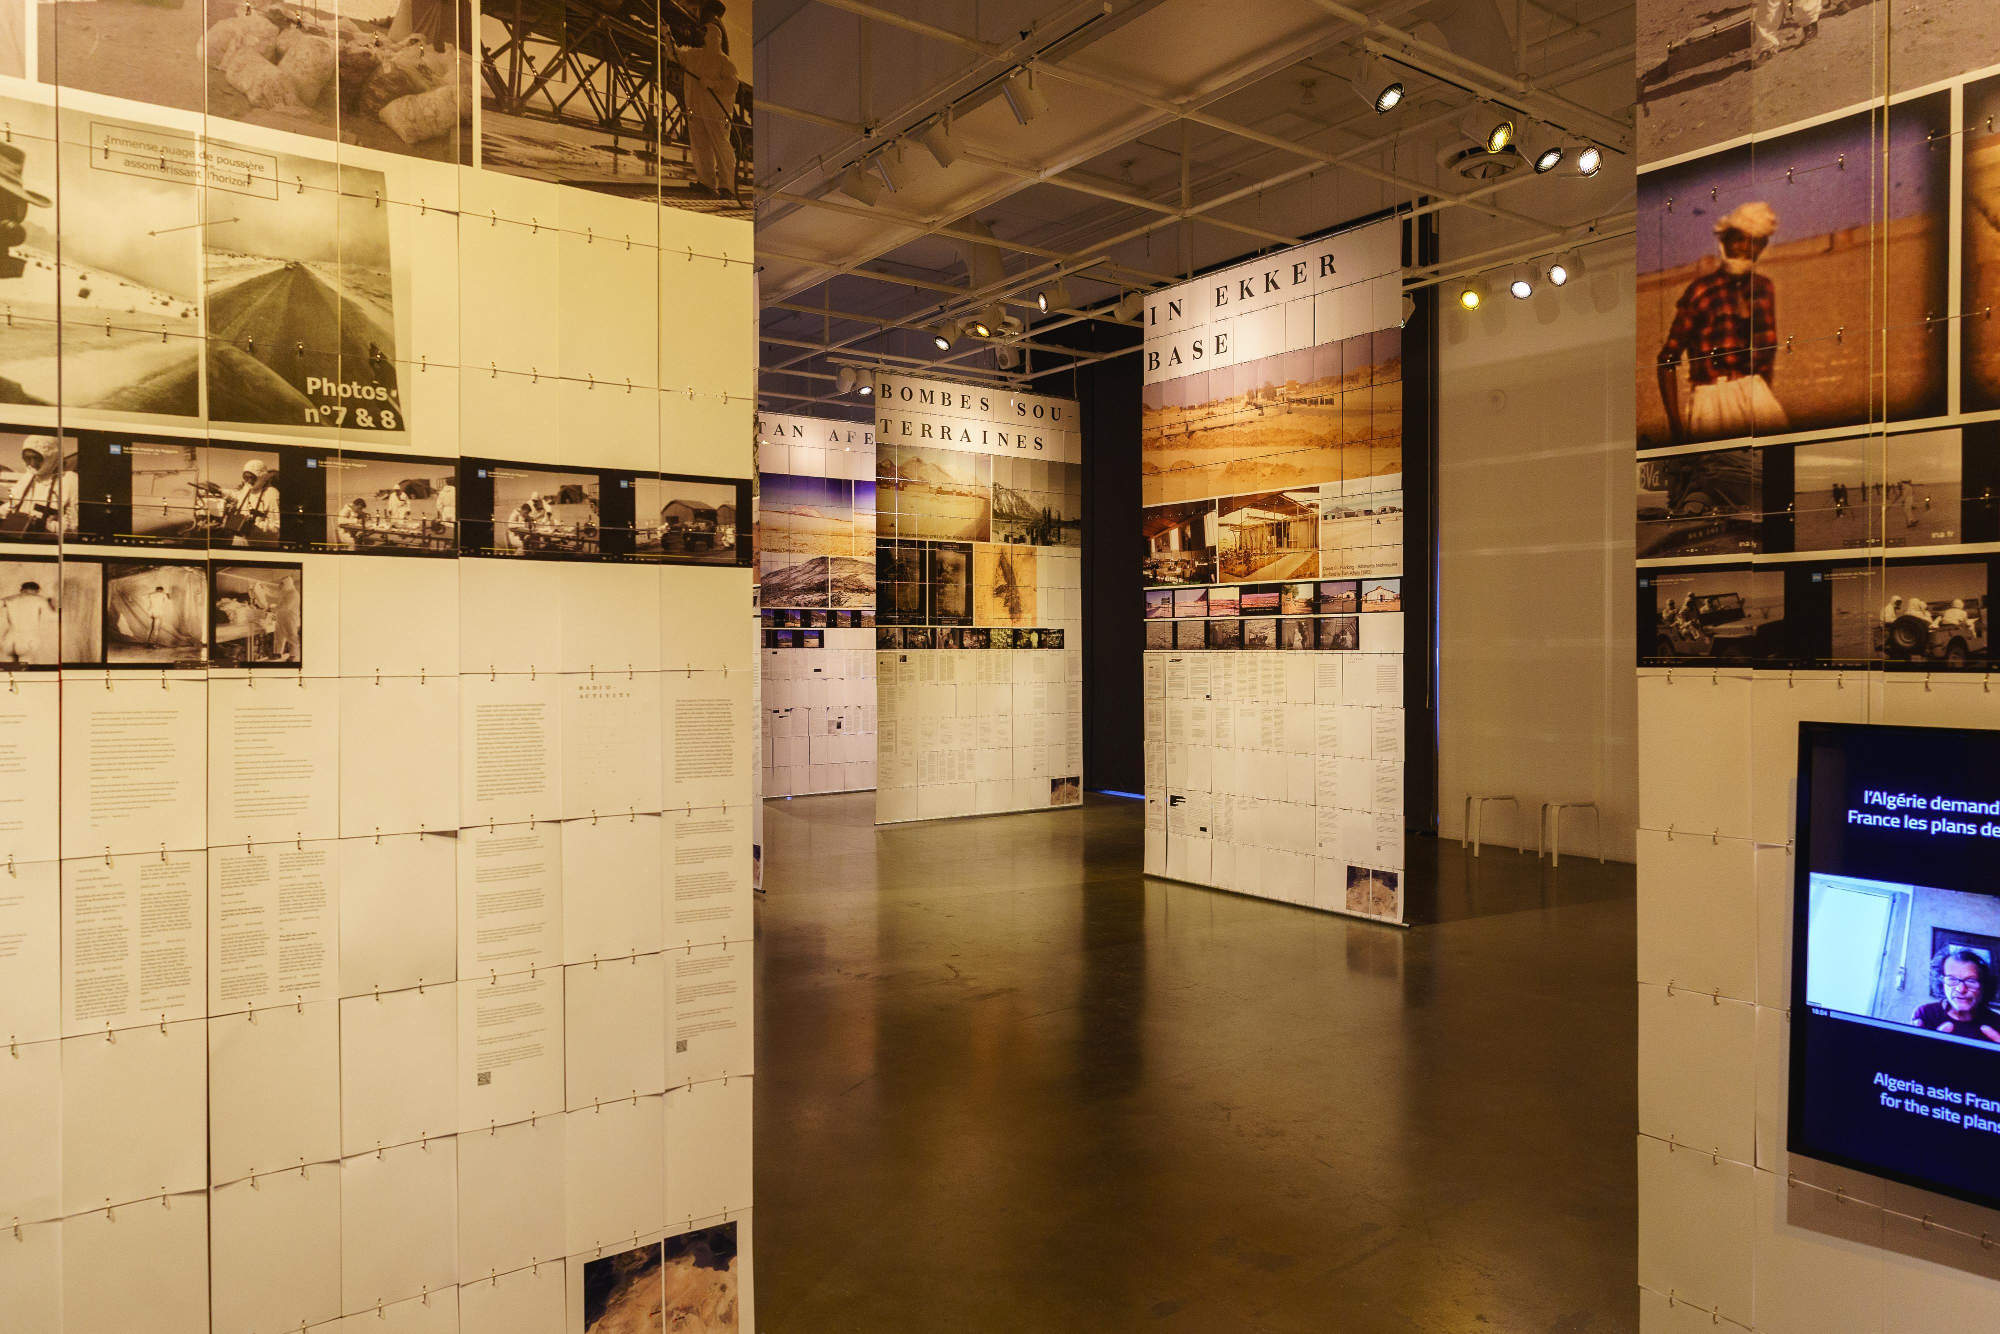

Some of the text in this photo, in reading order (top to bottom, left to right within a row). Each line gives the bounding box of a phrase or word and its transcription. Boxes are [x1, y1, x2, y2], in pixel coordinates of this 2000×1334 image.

[105, 135, 159, 153] Immense
[161, 145, 195, 159] nuage
[1148, 253, 1337, 326] IN EKKER
[1147, 333, 1228, 372] BASE
[306, 376, 388, 401] Photos
[880, 383, 990, 412] BOMBES
[355, 408, 376, 428] &
[380, 409, 397, 429] 8
[879, 418, 1044, 451] TERRAINES
[1863, 789, 1927, 810] l'Algérie
[1847, 809, 1900, 828] France
[1903, 814, 1928, 830] les
[1930, 818, 1977, 835] plans
[1873, 1072, 1925, 1096] Algeria
[1926, 1086, 1962, 1104] asks
[1880, 1092, 1902, 1108] for
[1904, 1098, 1930, 1116] the
[1931, 1107, 1960, 1124] site
